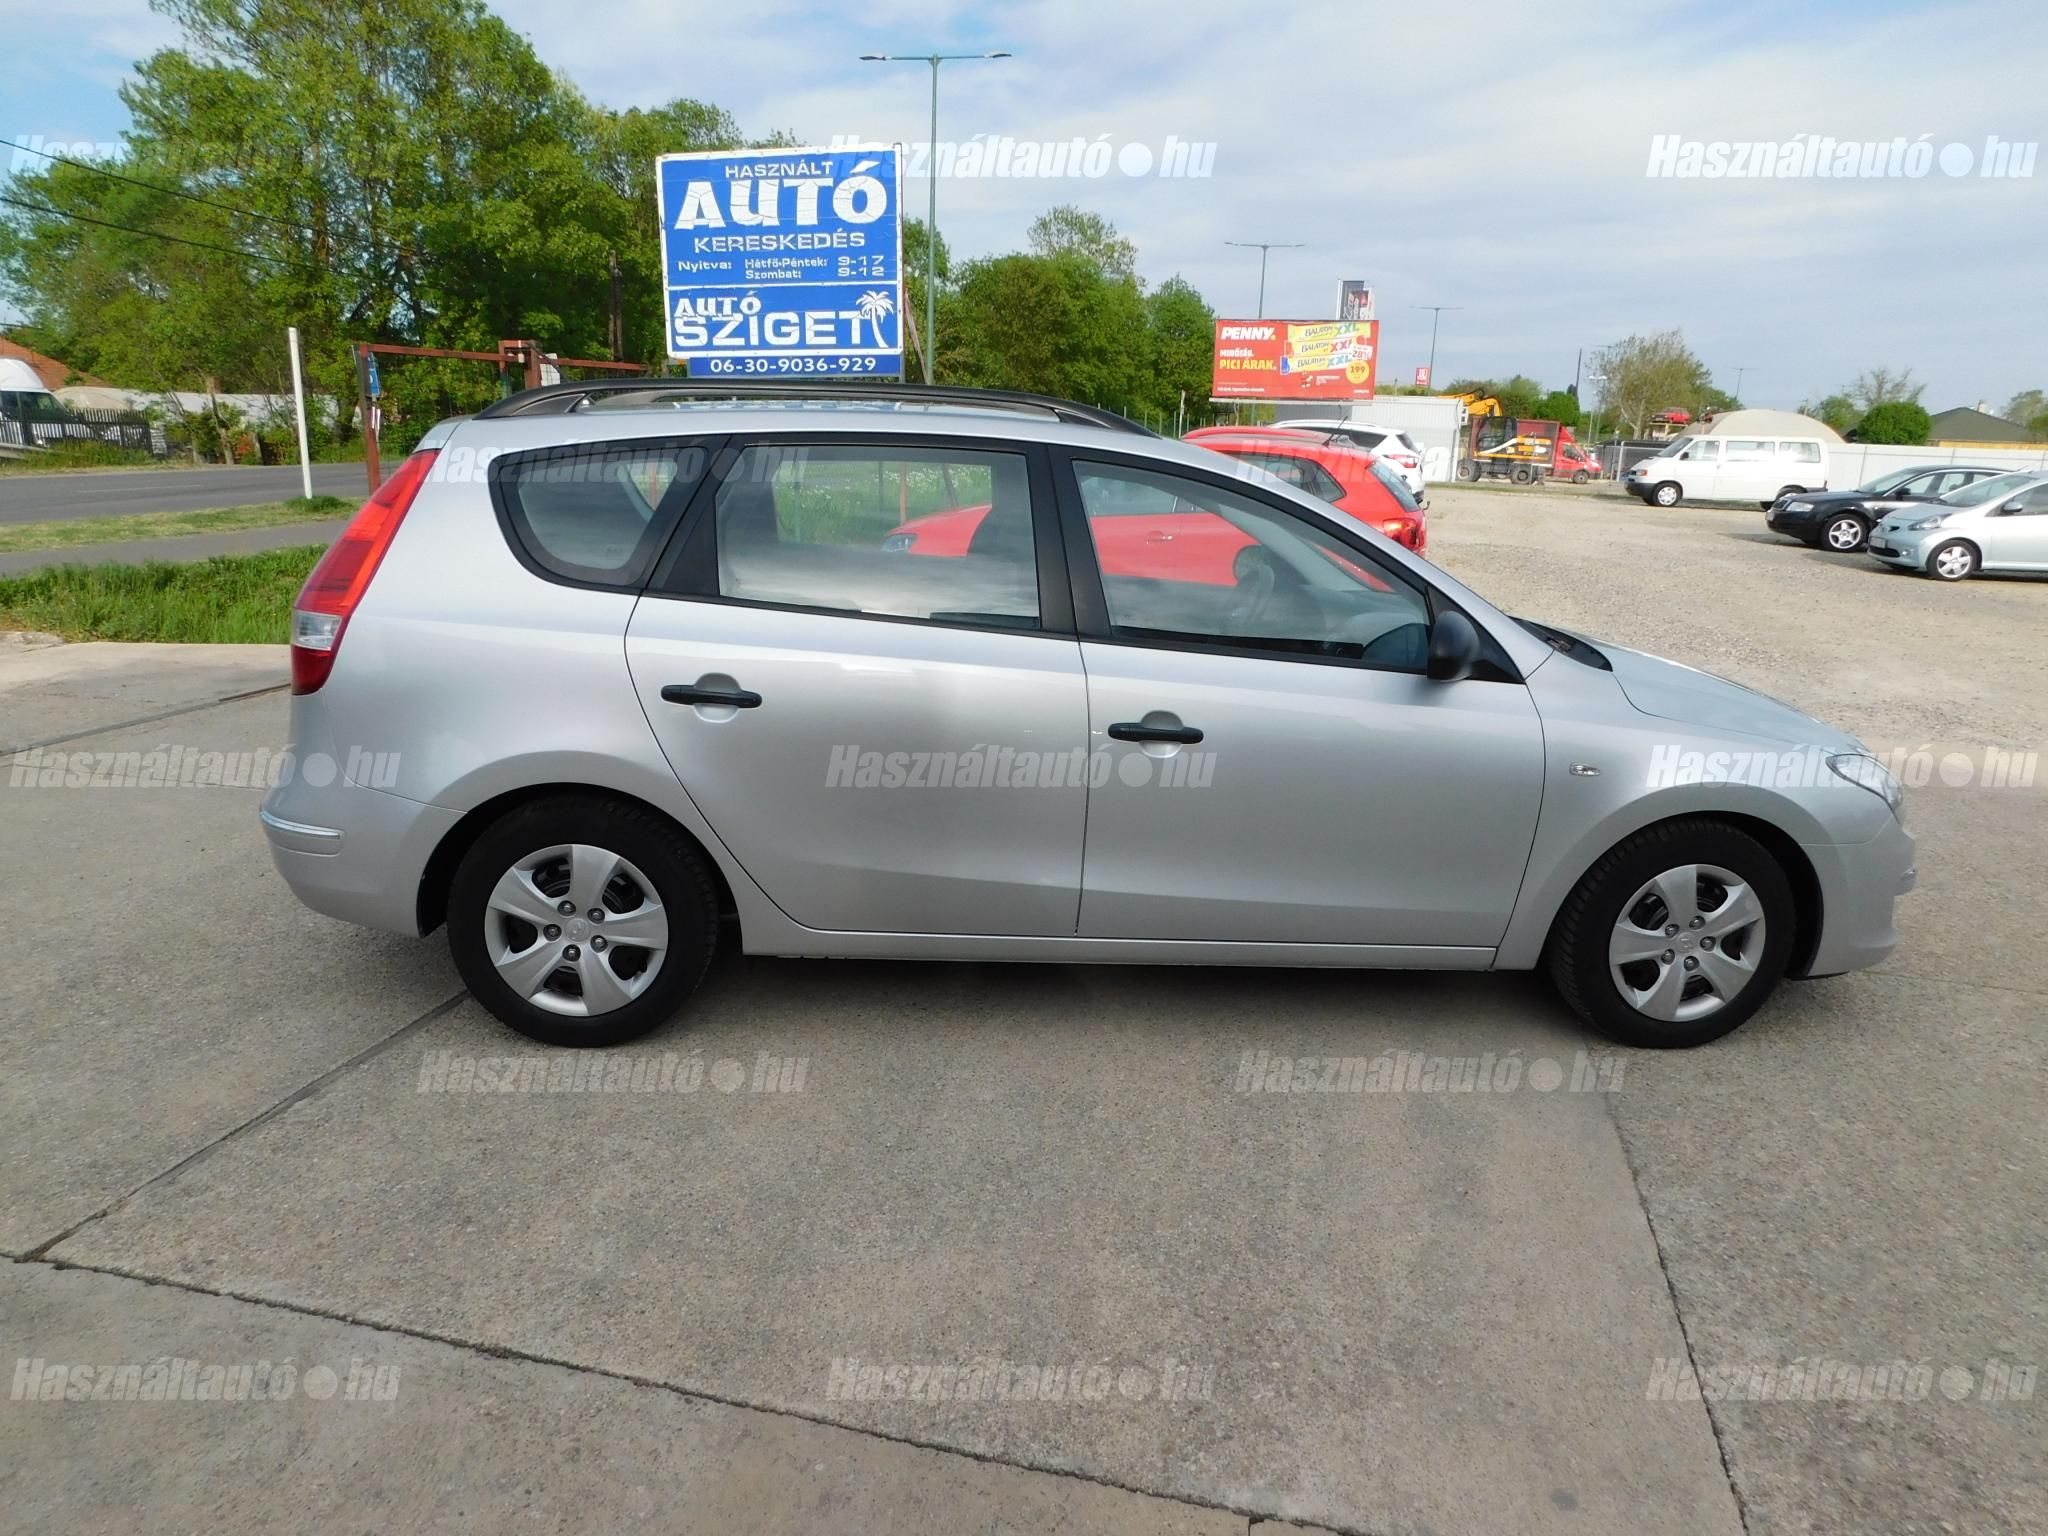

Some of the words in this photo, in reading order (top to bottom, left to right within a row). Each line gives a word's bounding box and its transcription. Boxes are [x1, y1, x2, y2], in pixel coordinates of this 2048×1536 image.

[725, 160, 833, 178] HASZNÁLT
[674, 160, 888, 230] AUTÓ
[694, 228, 865, 254] KERESKEDÉS
[678, 260, 732, 273] Nyitva:
[745, 268, 801, 280] Szombat:
[675, 291, 761, 318] AUTÓ
[674, 311, 870, 347] SZIGET
[710, 357, 877, 373] 06-30-9036-929
[1220, 359, 1241, 370] PICI
[1350, 365, 1366, 374] 199
